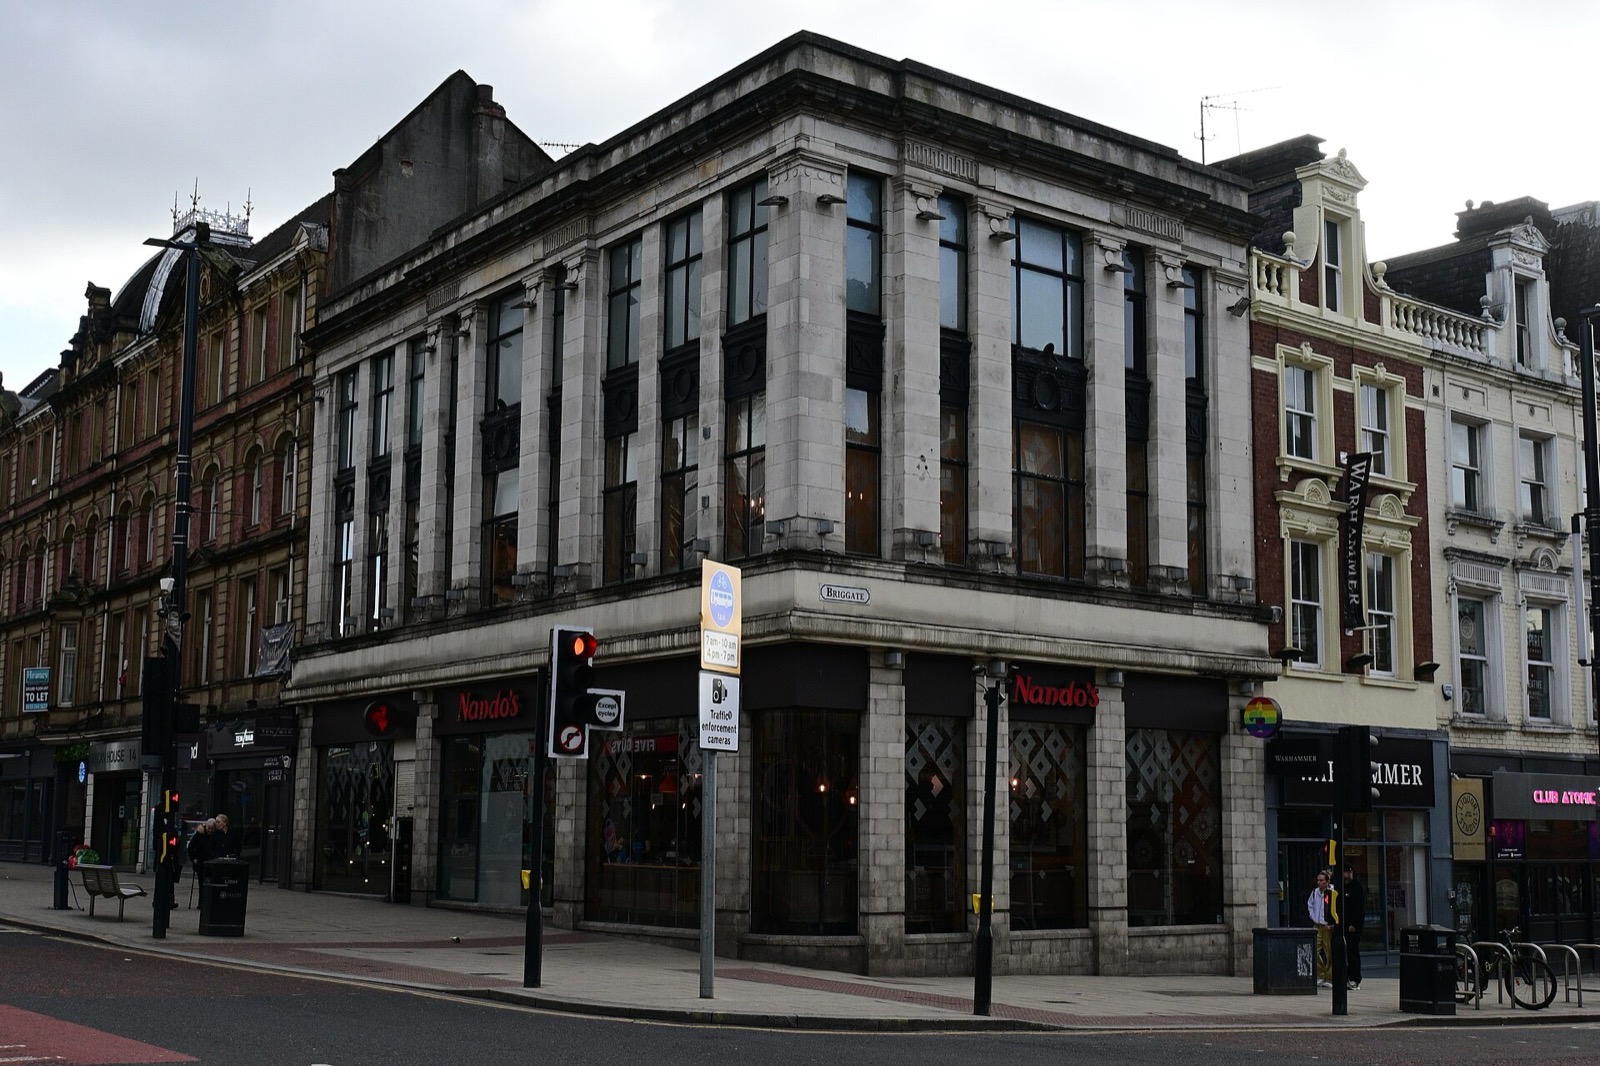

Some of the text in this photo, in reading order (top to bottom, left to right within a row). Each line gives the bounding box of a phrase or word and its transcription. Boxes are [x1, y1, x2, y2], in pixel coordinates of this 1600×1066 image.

[1347, 460, 1367, 605] WARHAMMER
[26, 692, 49, 702] TO LET
[1013, 675, 1099, 707] Nando's
[457, 689, 519, 721] Nando's
[598, 702, 617, 710] Except
[702, 721, 737, 733] enforcement
[707, 736, 731, 745] cameras
[106, 749, 124, 763] HOUSE
[129, 748, 136, 761] 14
[1274, 754, 1317, 762] WARHAMMER
[1458, 795, 1478, 810] LIQUOR
[1533, 790, 1597, 805] CLUB ATOMIC
[1458, 817, 1478, 833] STUDIO
